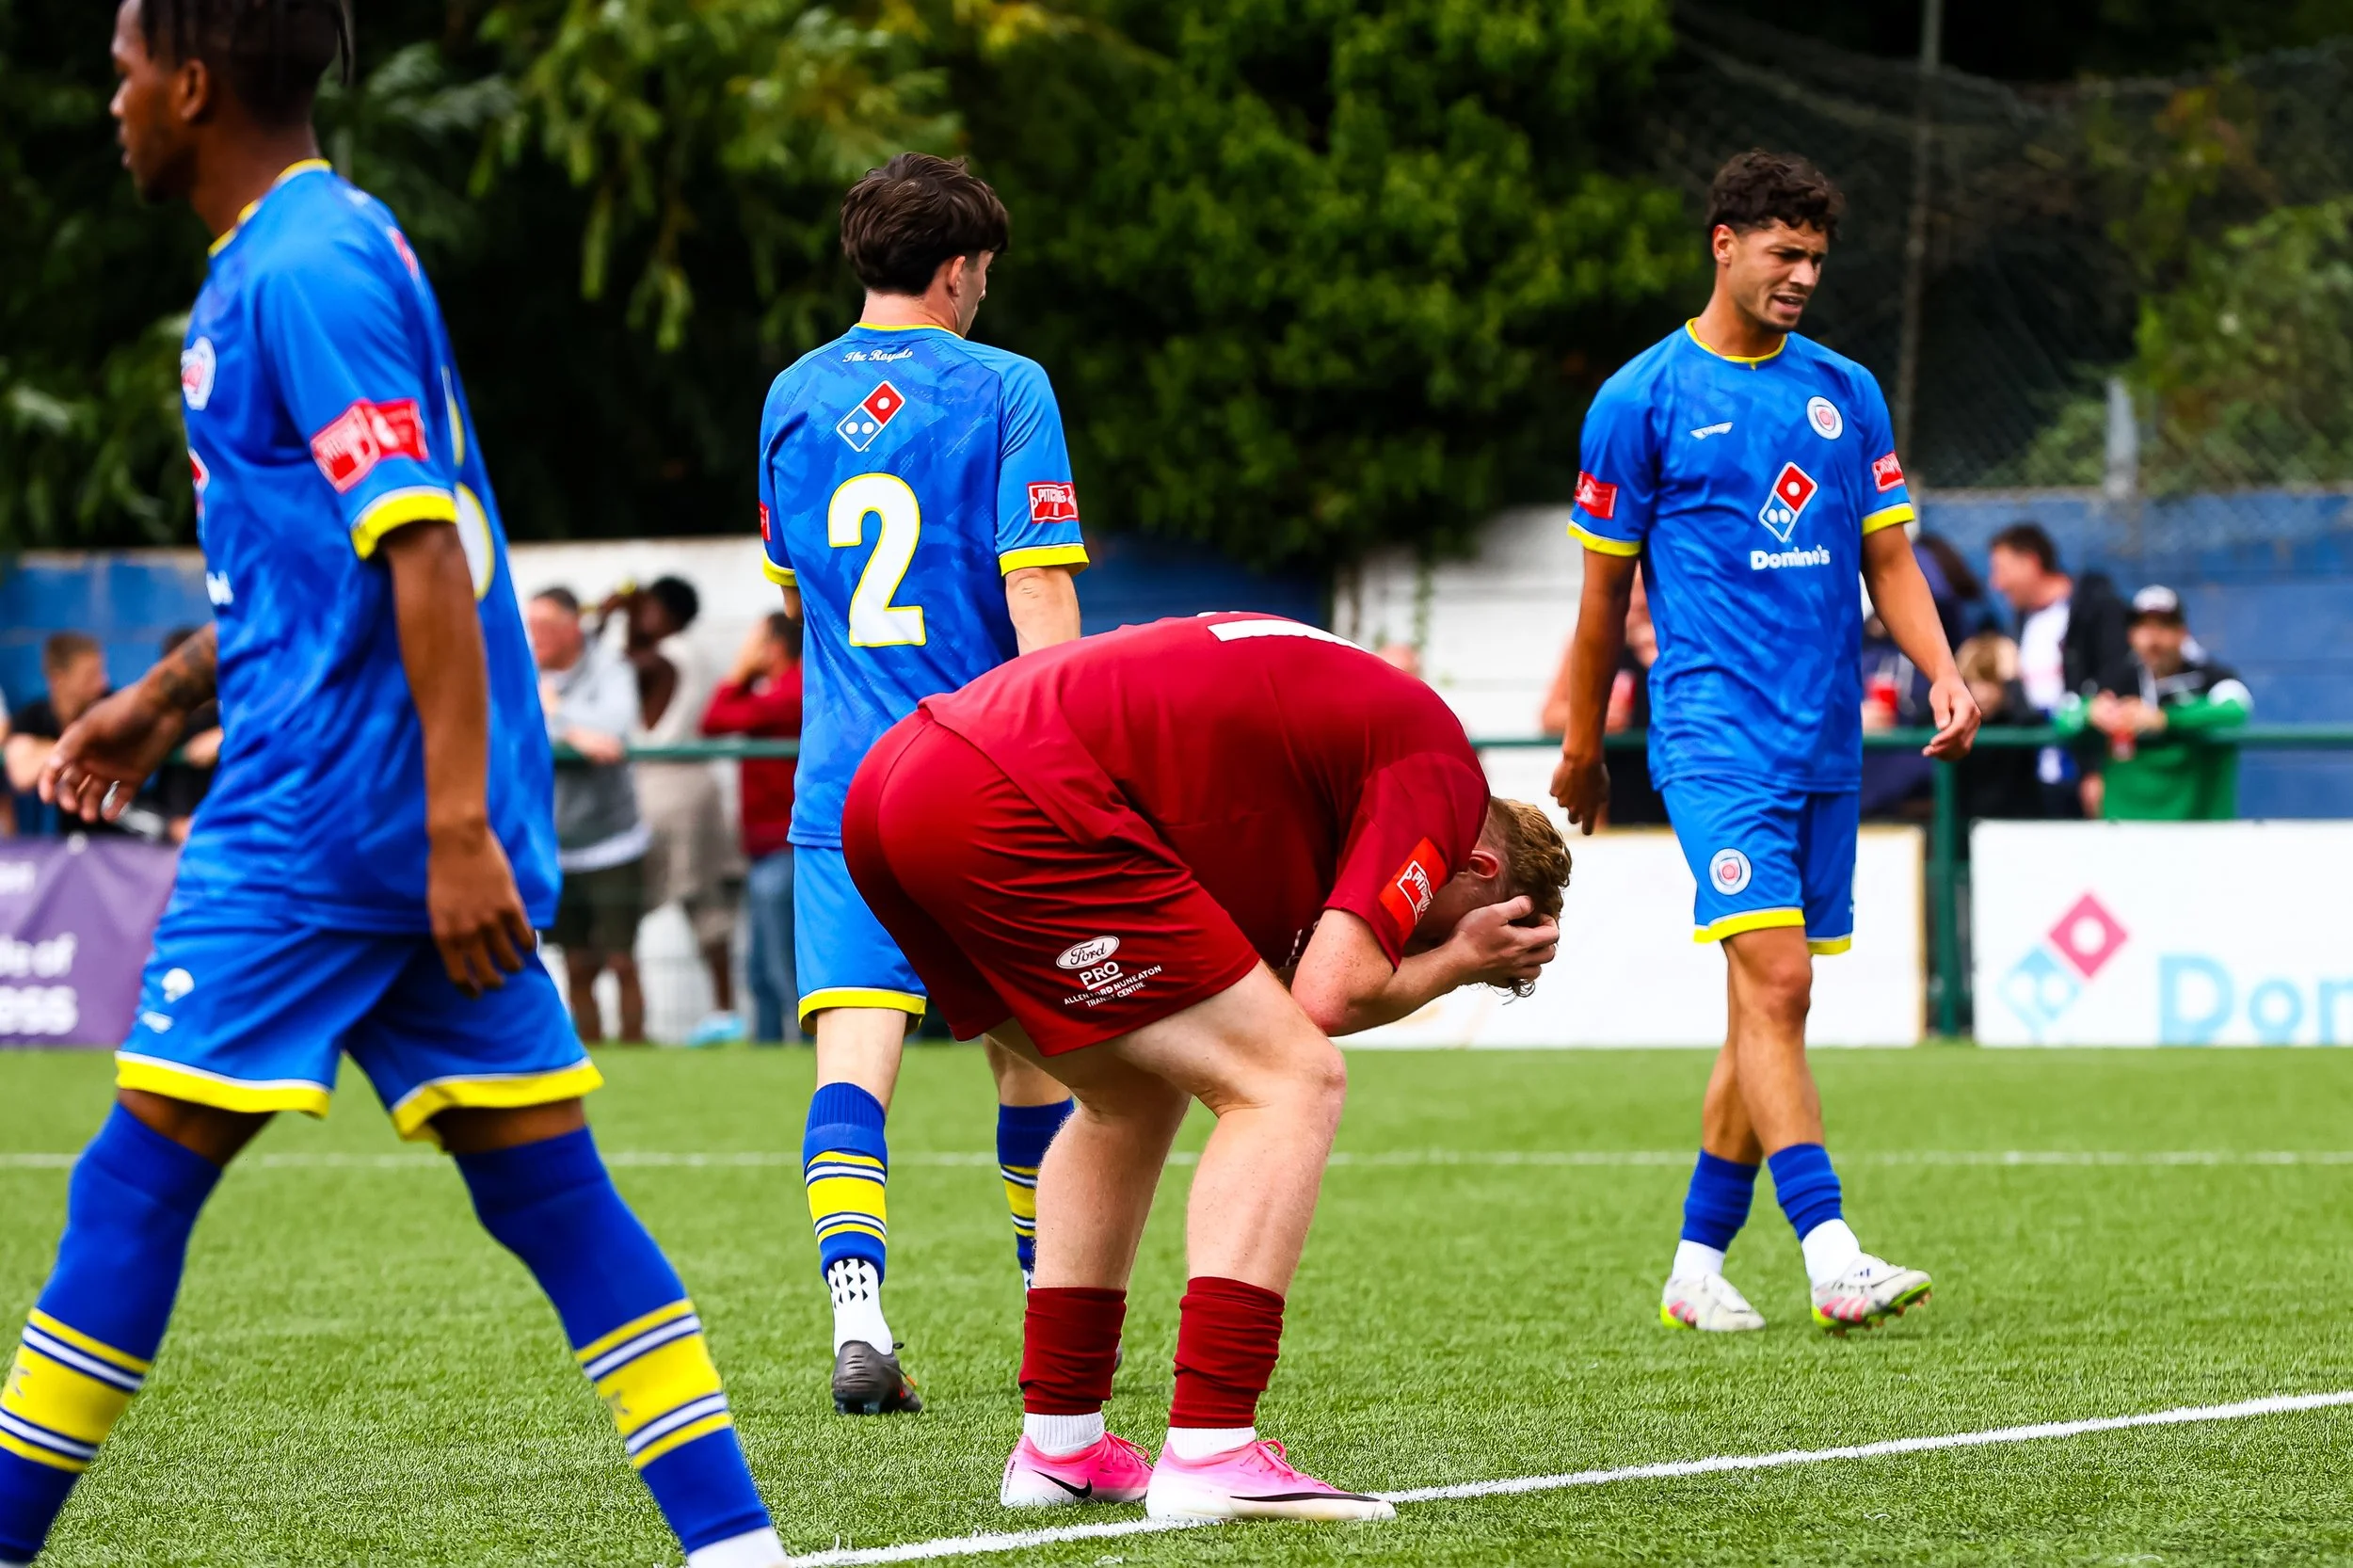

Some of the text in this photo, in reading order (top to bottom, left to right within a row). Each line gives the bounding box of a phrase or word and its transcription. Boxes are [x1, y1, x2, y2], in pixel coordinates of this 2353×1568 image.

[842, 348, 914, 363] The Royals
[828, 472, 926, 647] 2
[1751, 544, 1831, 571] Domino's
[1070, 942, 1108, 966] Ford
[1064, 993, 1090, 1005] ALLEN
[1112, 965, 1162, 991] NUNEATON
[1079, 961, 1120, 986] PRO
[1085, 981, 1146, 1008] TRANT CENTRE
